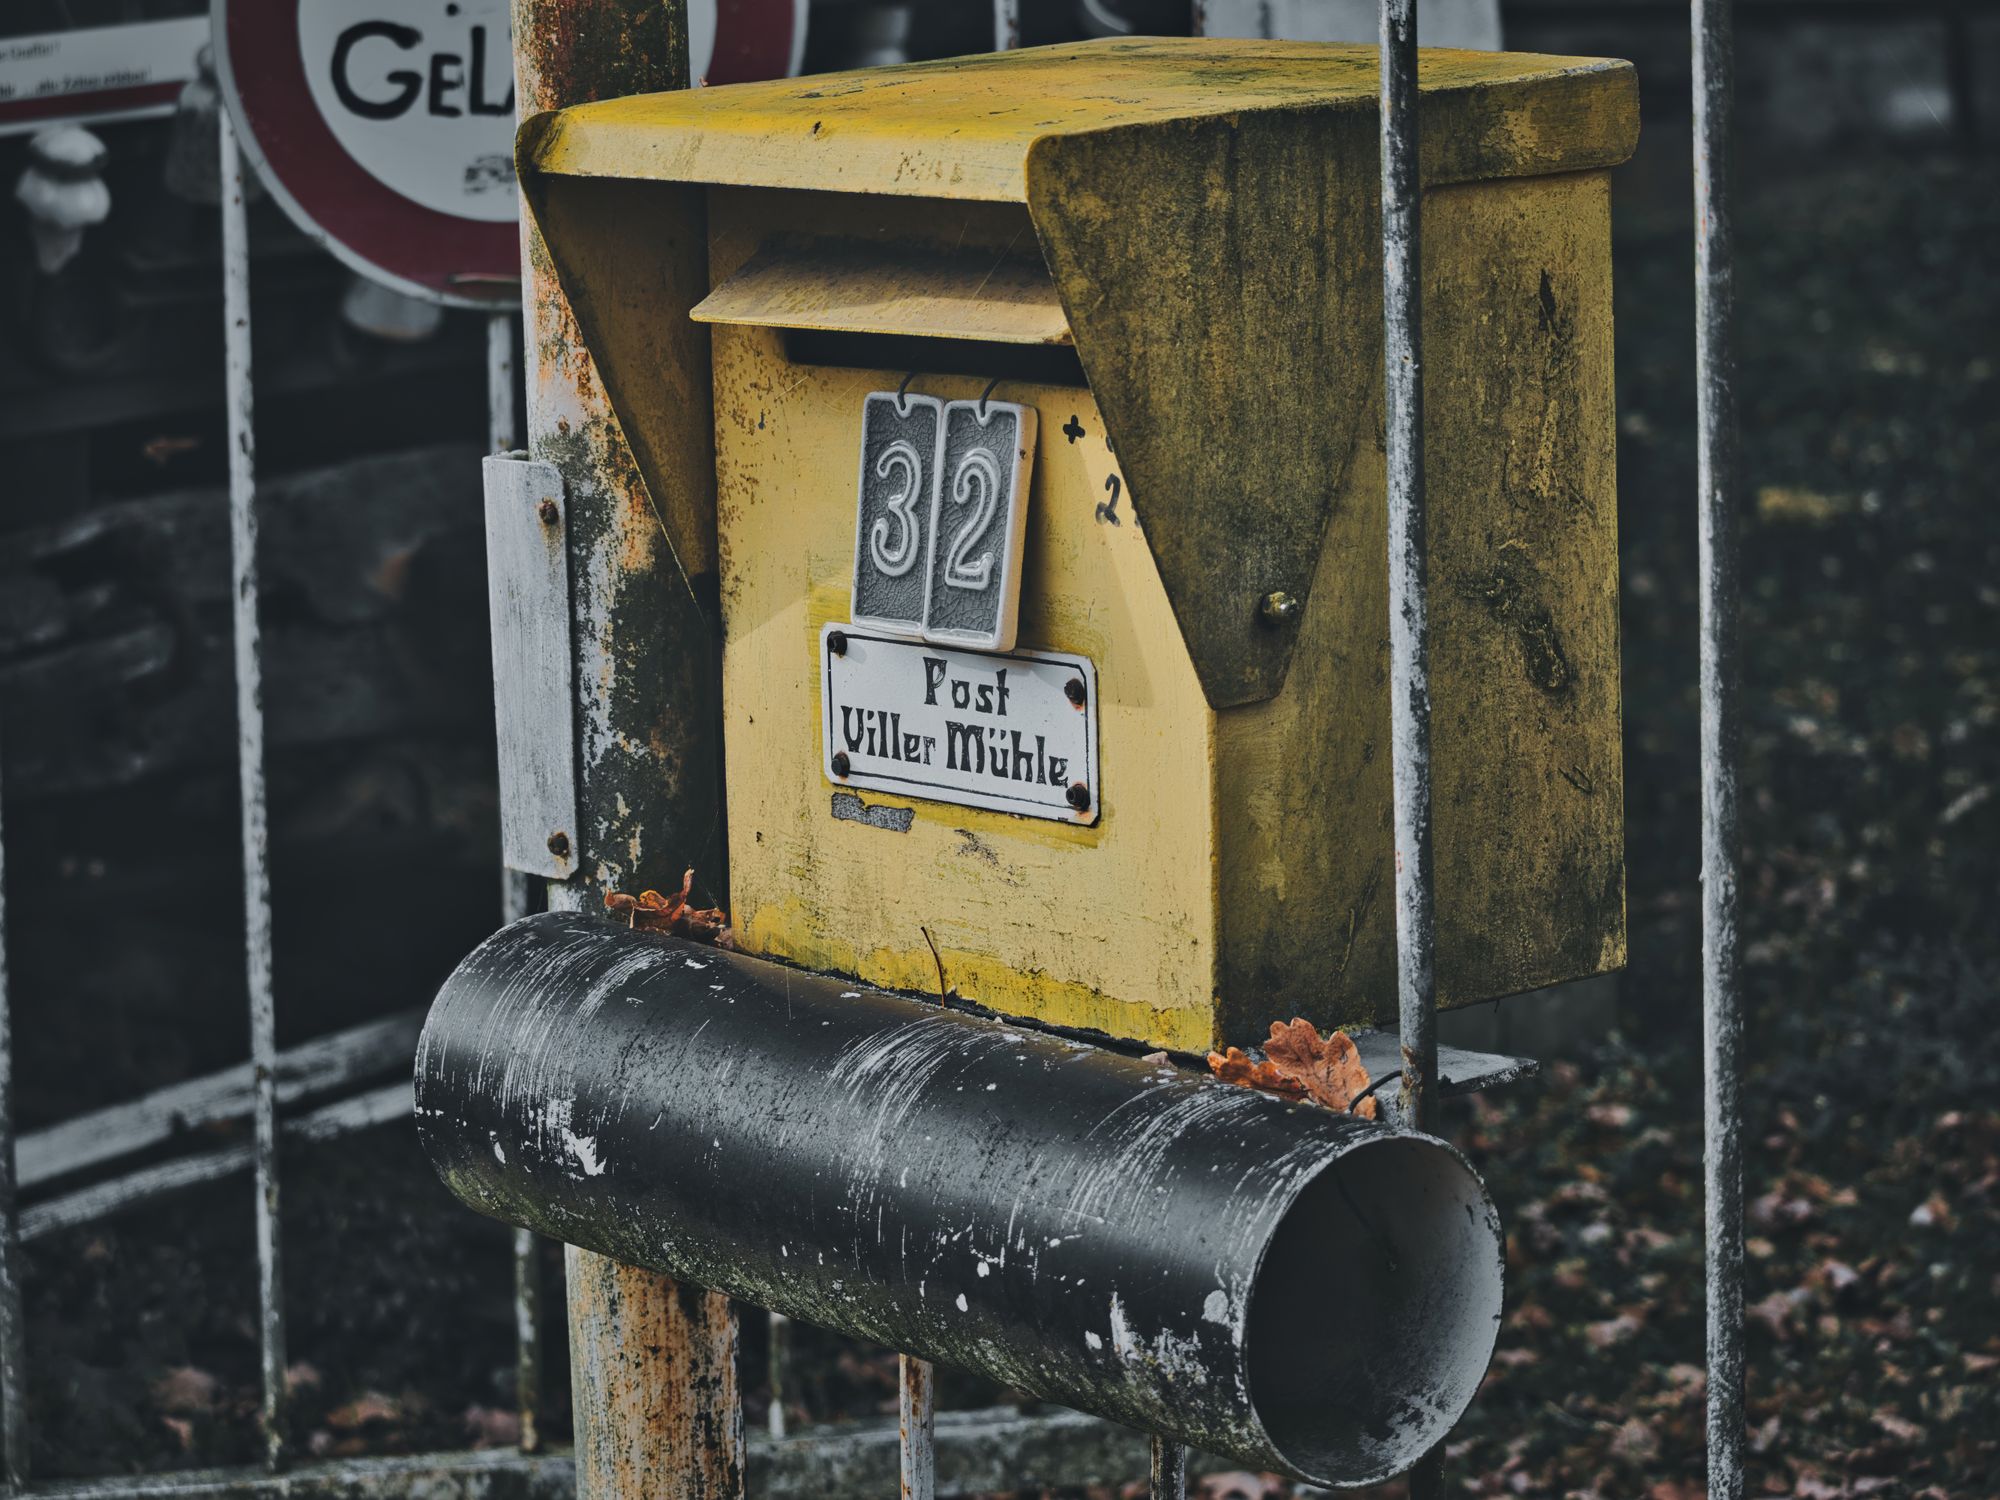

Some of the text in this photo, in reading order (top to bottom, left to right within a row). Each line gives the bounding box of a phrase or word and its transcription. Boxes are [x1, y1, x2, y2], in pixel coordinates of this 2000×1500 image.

[331, 20, 514, 120] GEL
[871, 440, 1000, 590] 32
[922, 656, 1010, 716] Post
[840, 705, 1069, 788] Viller Mühle
